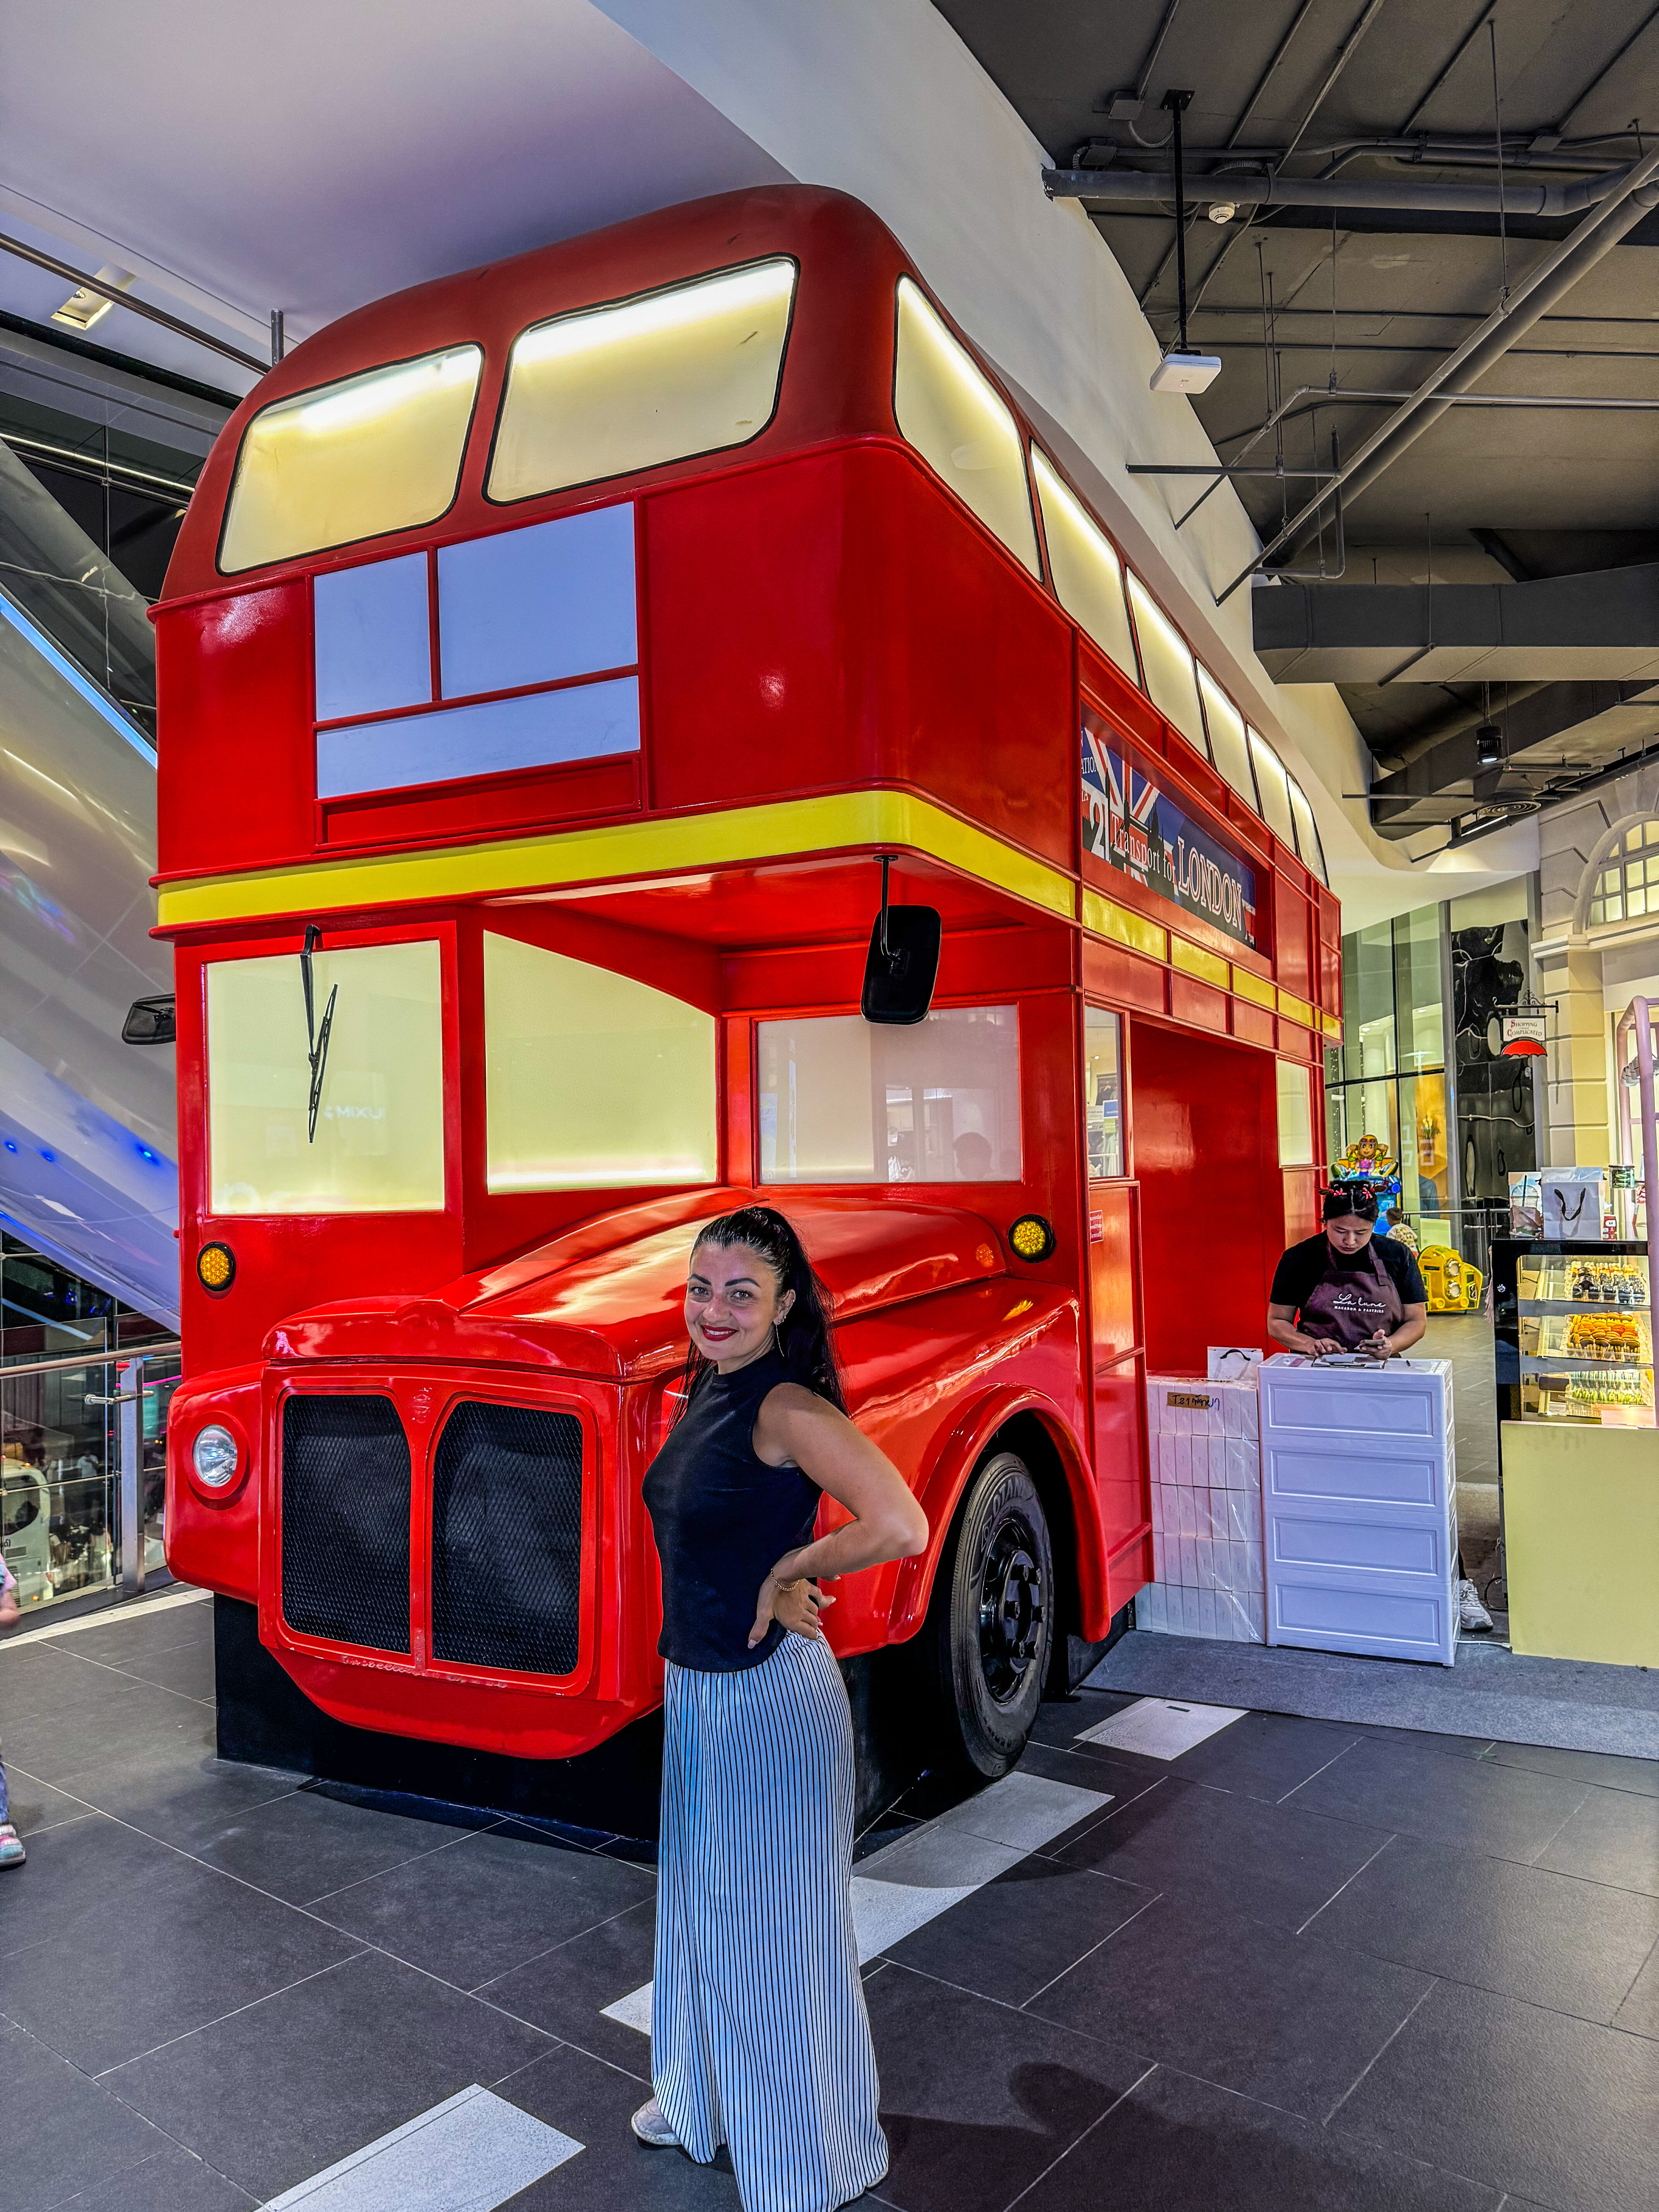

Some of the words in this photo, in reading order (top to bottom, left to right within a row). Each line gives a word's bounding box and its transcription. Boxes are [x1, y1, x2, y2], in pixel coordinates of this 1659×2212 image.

[1111, 813, 1161, 874] Transport
[1163, 849, 1176, 884] for
[1178, 835, 1242, 931] LONDON
[1507, 1029, 1542, 1037] COMPLICATED
[1333, 1293, 1357, 1305] La
[1358, 1297, 1386, 1307] lune
